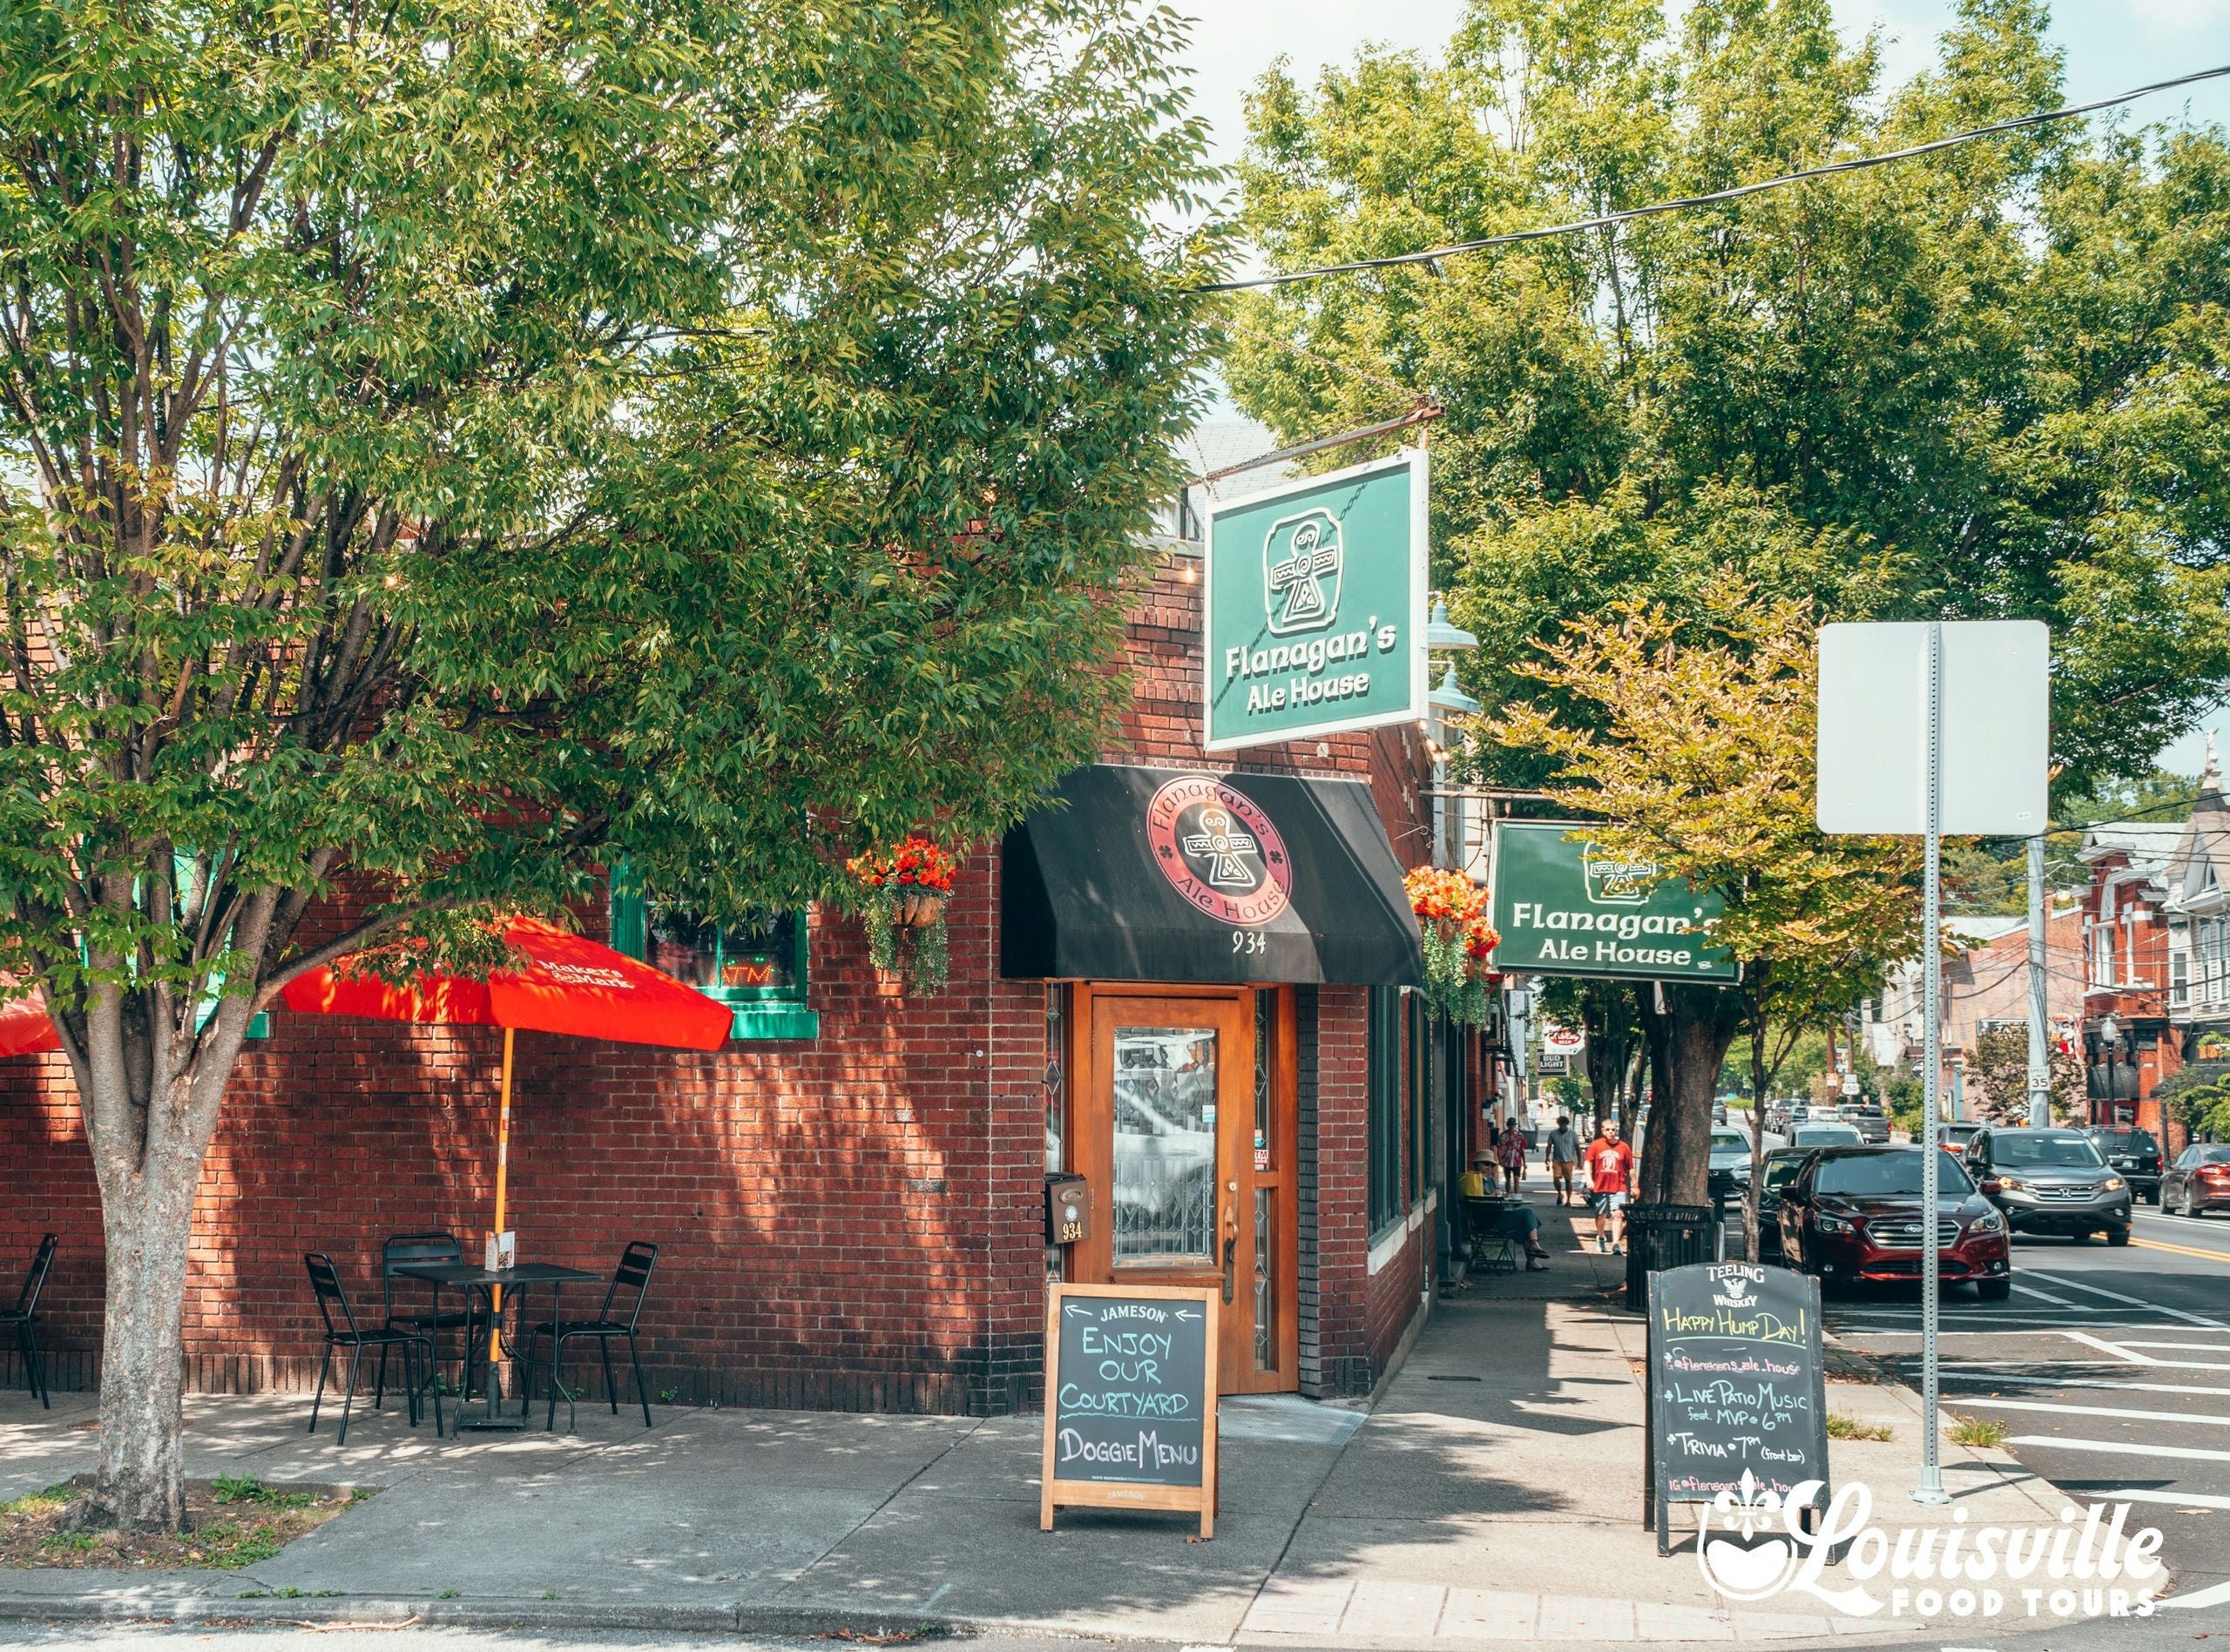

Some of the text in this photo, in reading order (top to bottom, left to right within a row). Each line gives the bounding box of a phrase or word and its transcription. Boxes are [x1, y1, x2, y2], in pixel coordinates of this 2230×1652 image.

[1226, 616, 1396, 678] Flanagan's
[1247, 673, 1370, 711] Ale House
[1153, 784, 1269, 835] Flanagan's
[1178, 877, 1286, 919] Ale House
[1512, 902, 1722, 940] Flanagan's
[1233, 931, 1266, 954] 934
[1538, 939, 1691, 966] Ale House
[537, 960, 624, 978] Maker's
[571, 974, 635, 989] Mark
[2032, 1078, 2048, 1088] 35
[1063, 1221, 1082, 1240] 934
[1706, 1264, 1765, 1283] TEELING
[1100, 1305, 1167, 1323] JAMESON
[1713, 1294, 1758, 1308] WHISKEY
[1663, 1307, 1806, 1344] HAPPY HUMP DAY!
[1083, 1327, 1172, 1359] ENJOY
[1099, 1359, 1161, 1385] OUR
[1059, 1383, 1189, 1415] COURTYARD
[1674, 1379, 1808, 1411] LIVE PATIO MUSIC
[1716, 1409, 1748, 1426] MVP
[1058, 1428, 1198, 1470] DOGGIE MENU
[1675, 1432, 1727, 1458] TRIVIA
[1106, 1490, 1145, 1500] JAMESON
